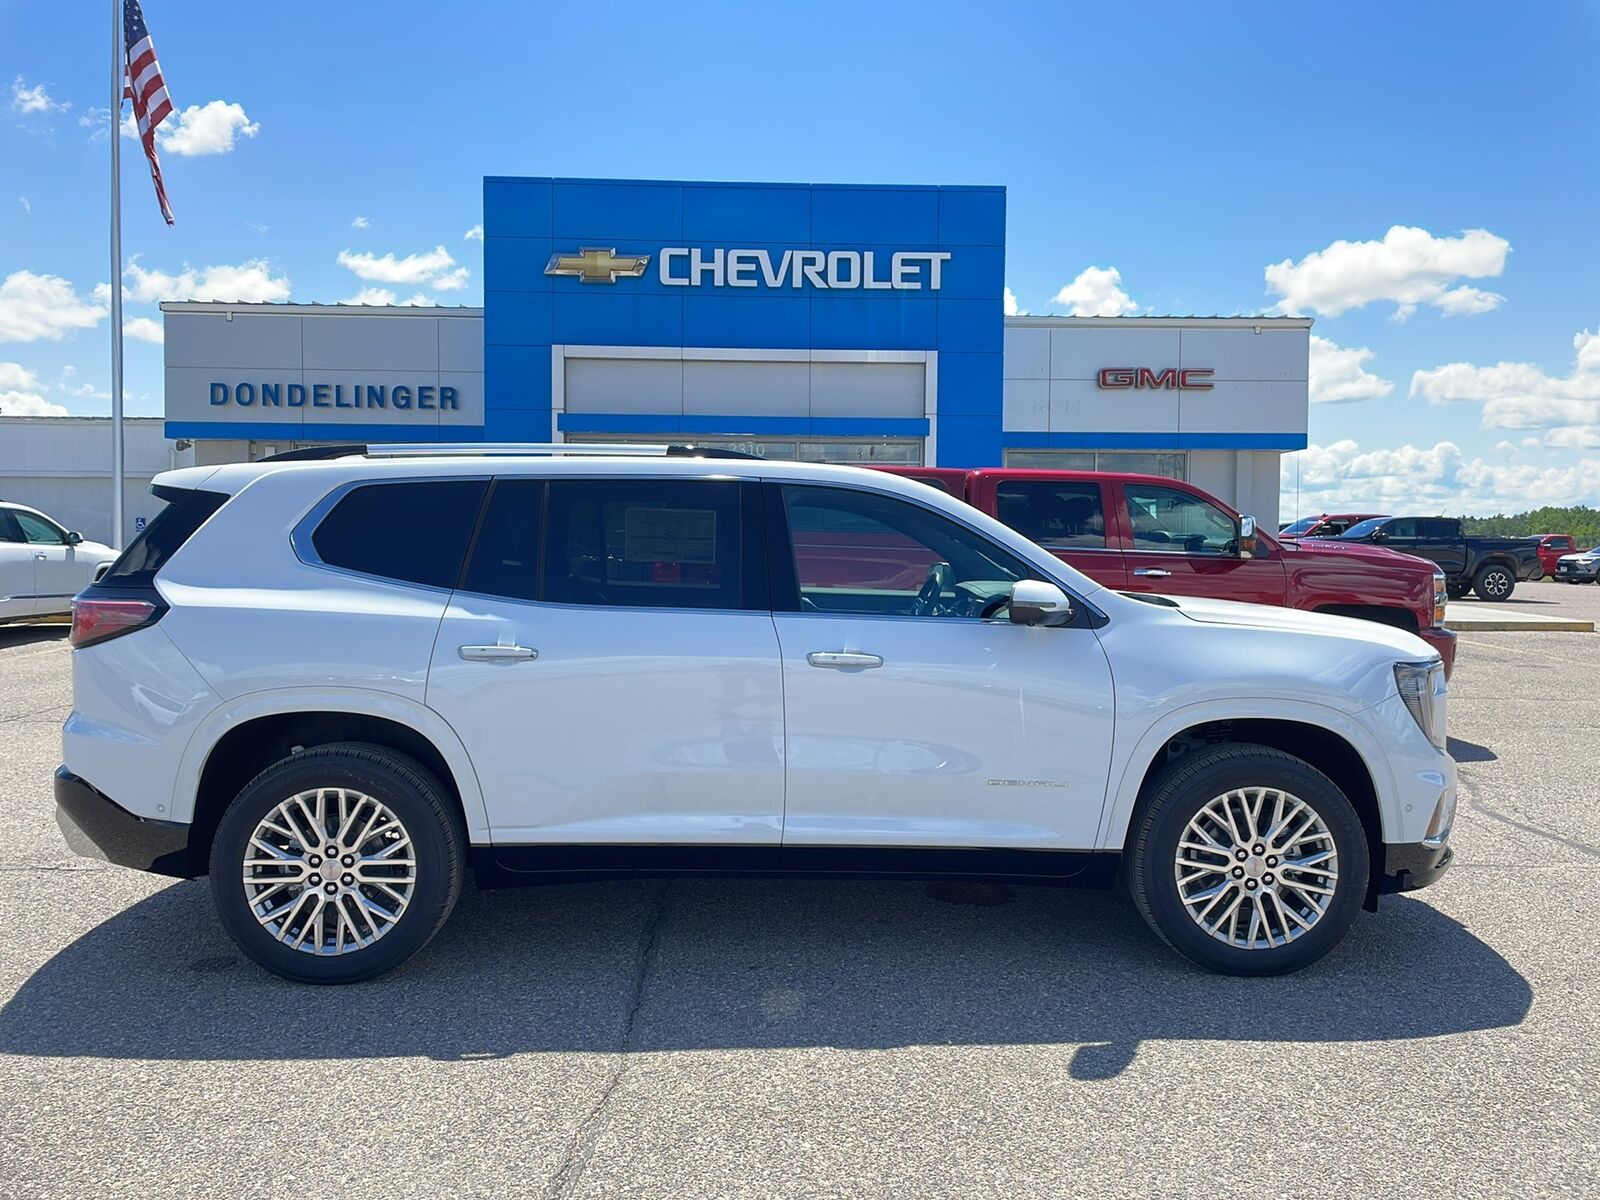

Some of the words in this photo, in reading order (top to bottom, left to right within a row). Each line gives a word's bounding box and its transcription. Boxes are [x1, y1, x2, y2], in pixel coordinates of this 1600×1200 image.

[659, 247, 951, 290] CHEVROLET
[1098, 367, 1215, 390] GMC
[210, 382, 460, 410] DONDELINGER
